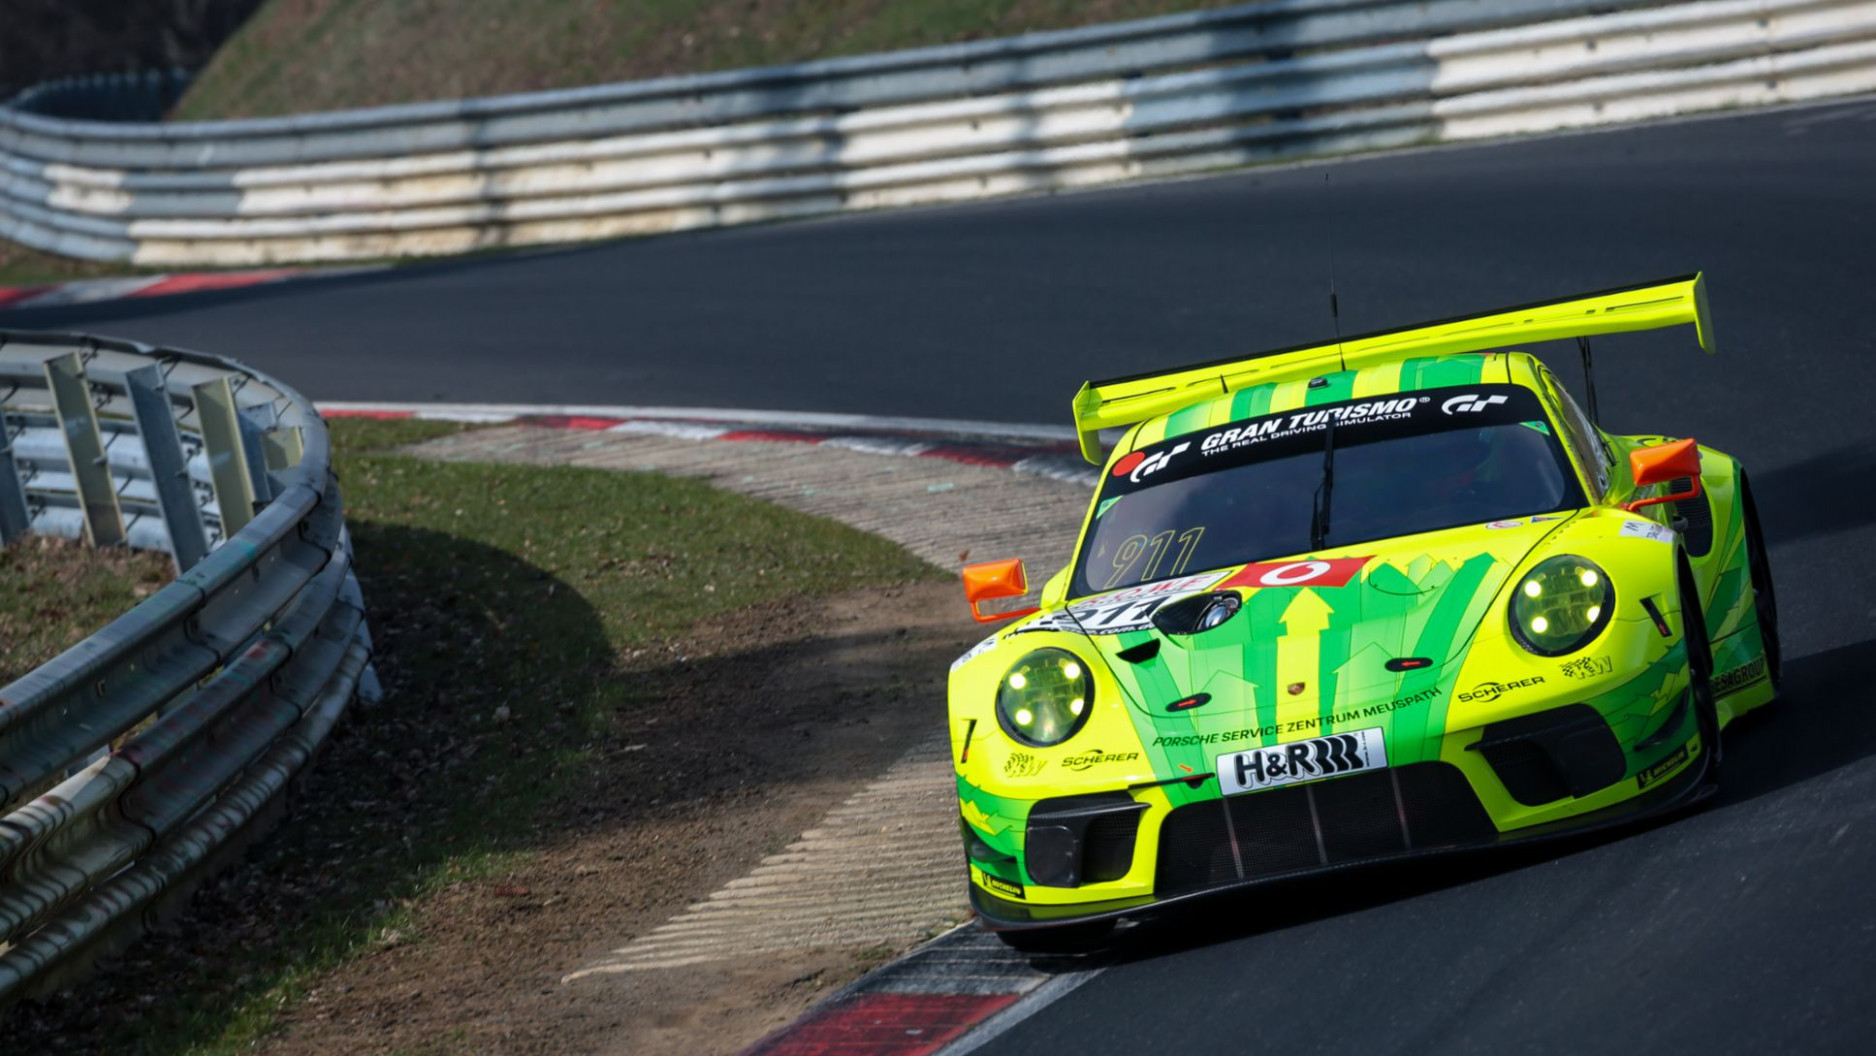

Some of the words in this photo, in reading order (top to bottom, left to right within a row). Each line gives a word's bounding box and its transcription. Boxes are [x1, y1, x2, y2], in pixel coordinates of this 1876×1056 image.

[1201, 418, 1283, 451] GRAN
[1202, 444, 1229, 457] THE
[1232, 435, 1268, 449] REAL
[1271, 423, 1327, 440] DRIVING
[1103, 526, 1205, 590] 911
[1458, 675, 1546, 702] SCHERER
[1152, 733, 1219, 748] PORSCHE
[1222, 723, 1284, 743] SERVICE
[1286, 710, 1360, 732] ZENTRUM
[1363, 687, 1442, 718] MEUSPATH
[1061, 752, 1139, 767] SCHERER
